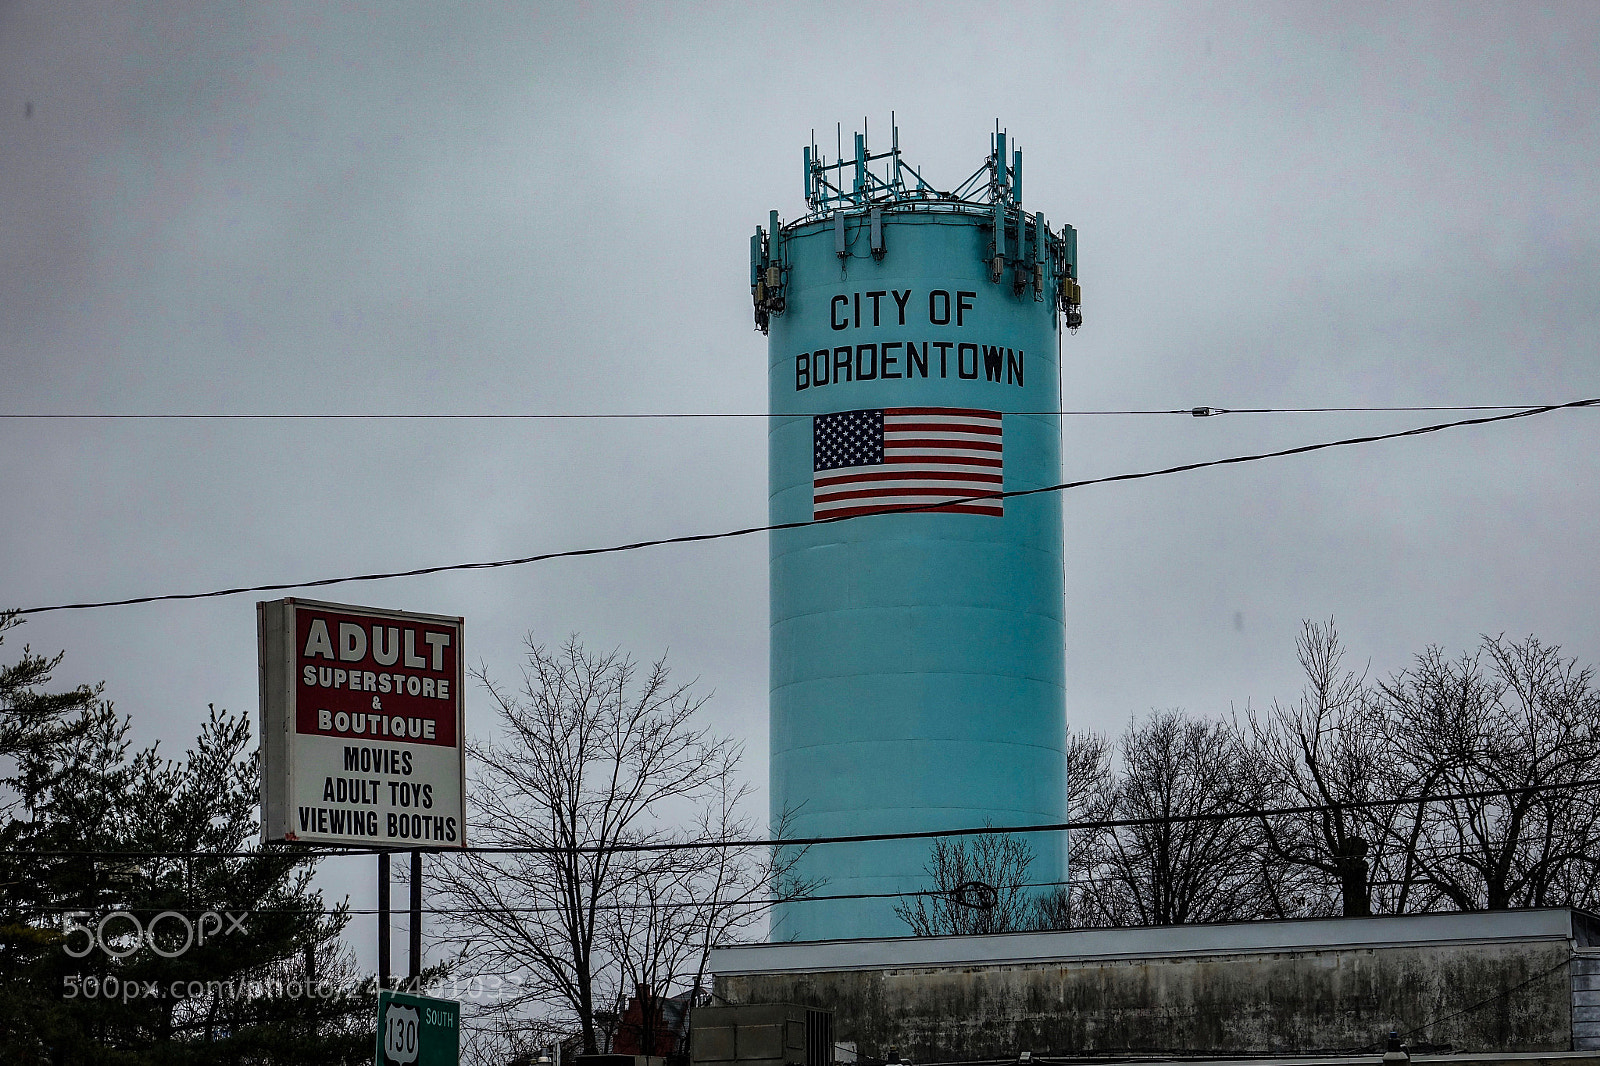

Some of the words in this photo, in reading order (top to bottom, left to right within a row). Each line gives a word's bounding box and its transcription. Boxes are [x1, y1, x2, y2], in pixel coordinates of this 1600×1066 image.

[830, 289, 912, 331] CITY
[929, 289, 977, 327] OF
[795, 341, 1024, 392] BORDENTOWN
[303, 618, 451, 671] ADULT
[303, 665, 450, 700] SUPERSTORE
[371, 695, 382, 710] &
[318, 709, 436, 740] BOUTIQUE
[344, 746, 413, 776] MOVIES
[323, 777, 380, 805] ADULT
[388, 781, 433, 809] TOYS
[299, 806, 378, 837] VIEWING
[387, 812, 457, 842] BOOTHS
[425, 1007, 454, 1028] SOUTH
[389, 1017, 415, 1054] 130
